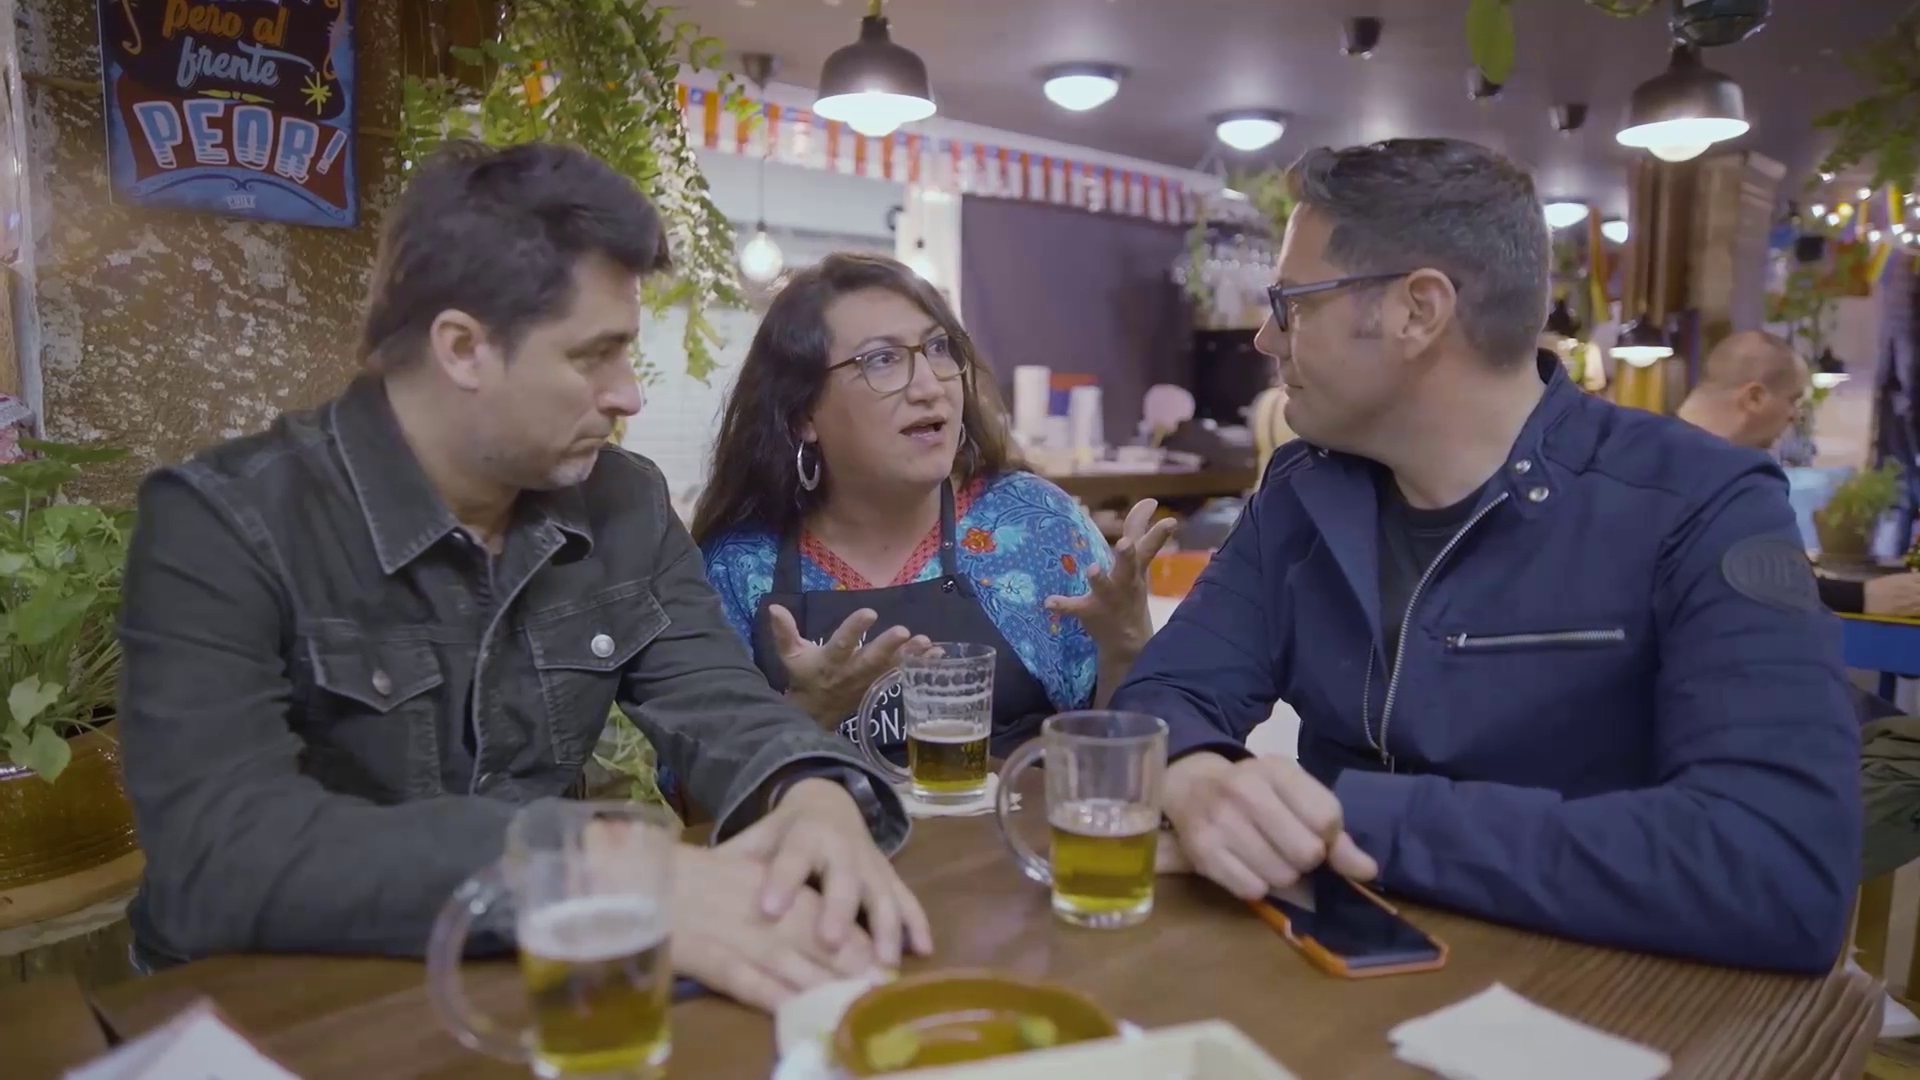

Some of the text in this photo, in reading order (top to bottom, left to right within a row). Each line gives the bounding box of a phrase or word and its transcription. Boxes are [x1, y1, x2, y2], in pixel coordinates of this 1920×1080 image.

[253, 6, 289, 47] al
[177, 36, 315, 88] frente
[132, 100, 347, 184] PEOR!
